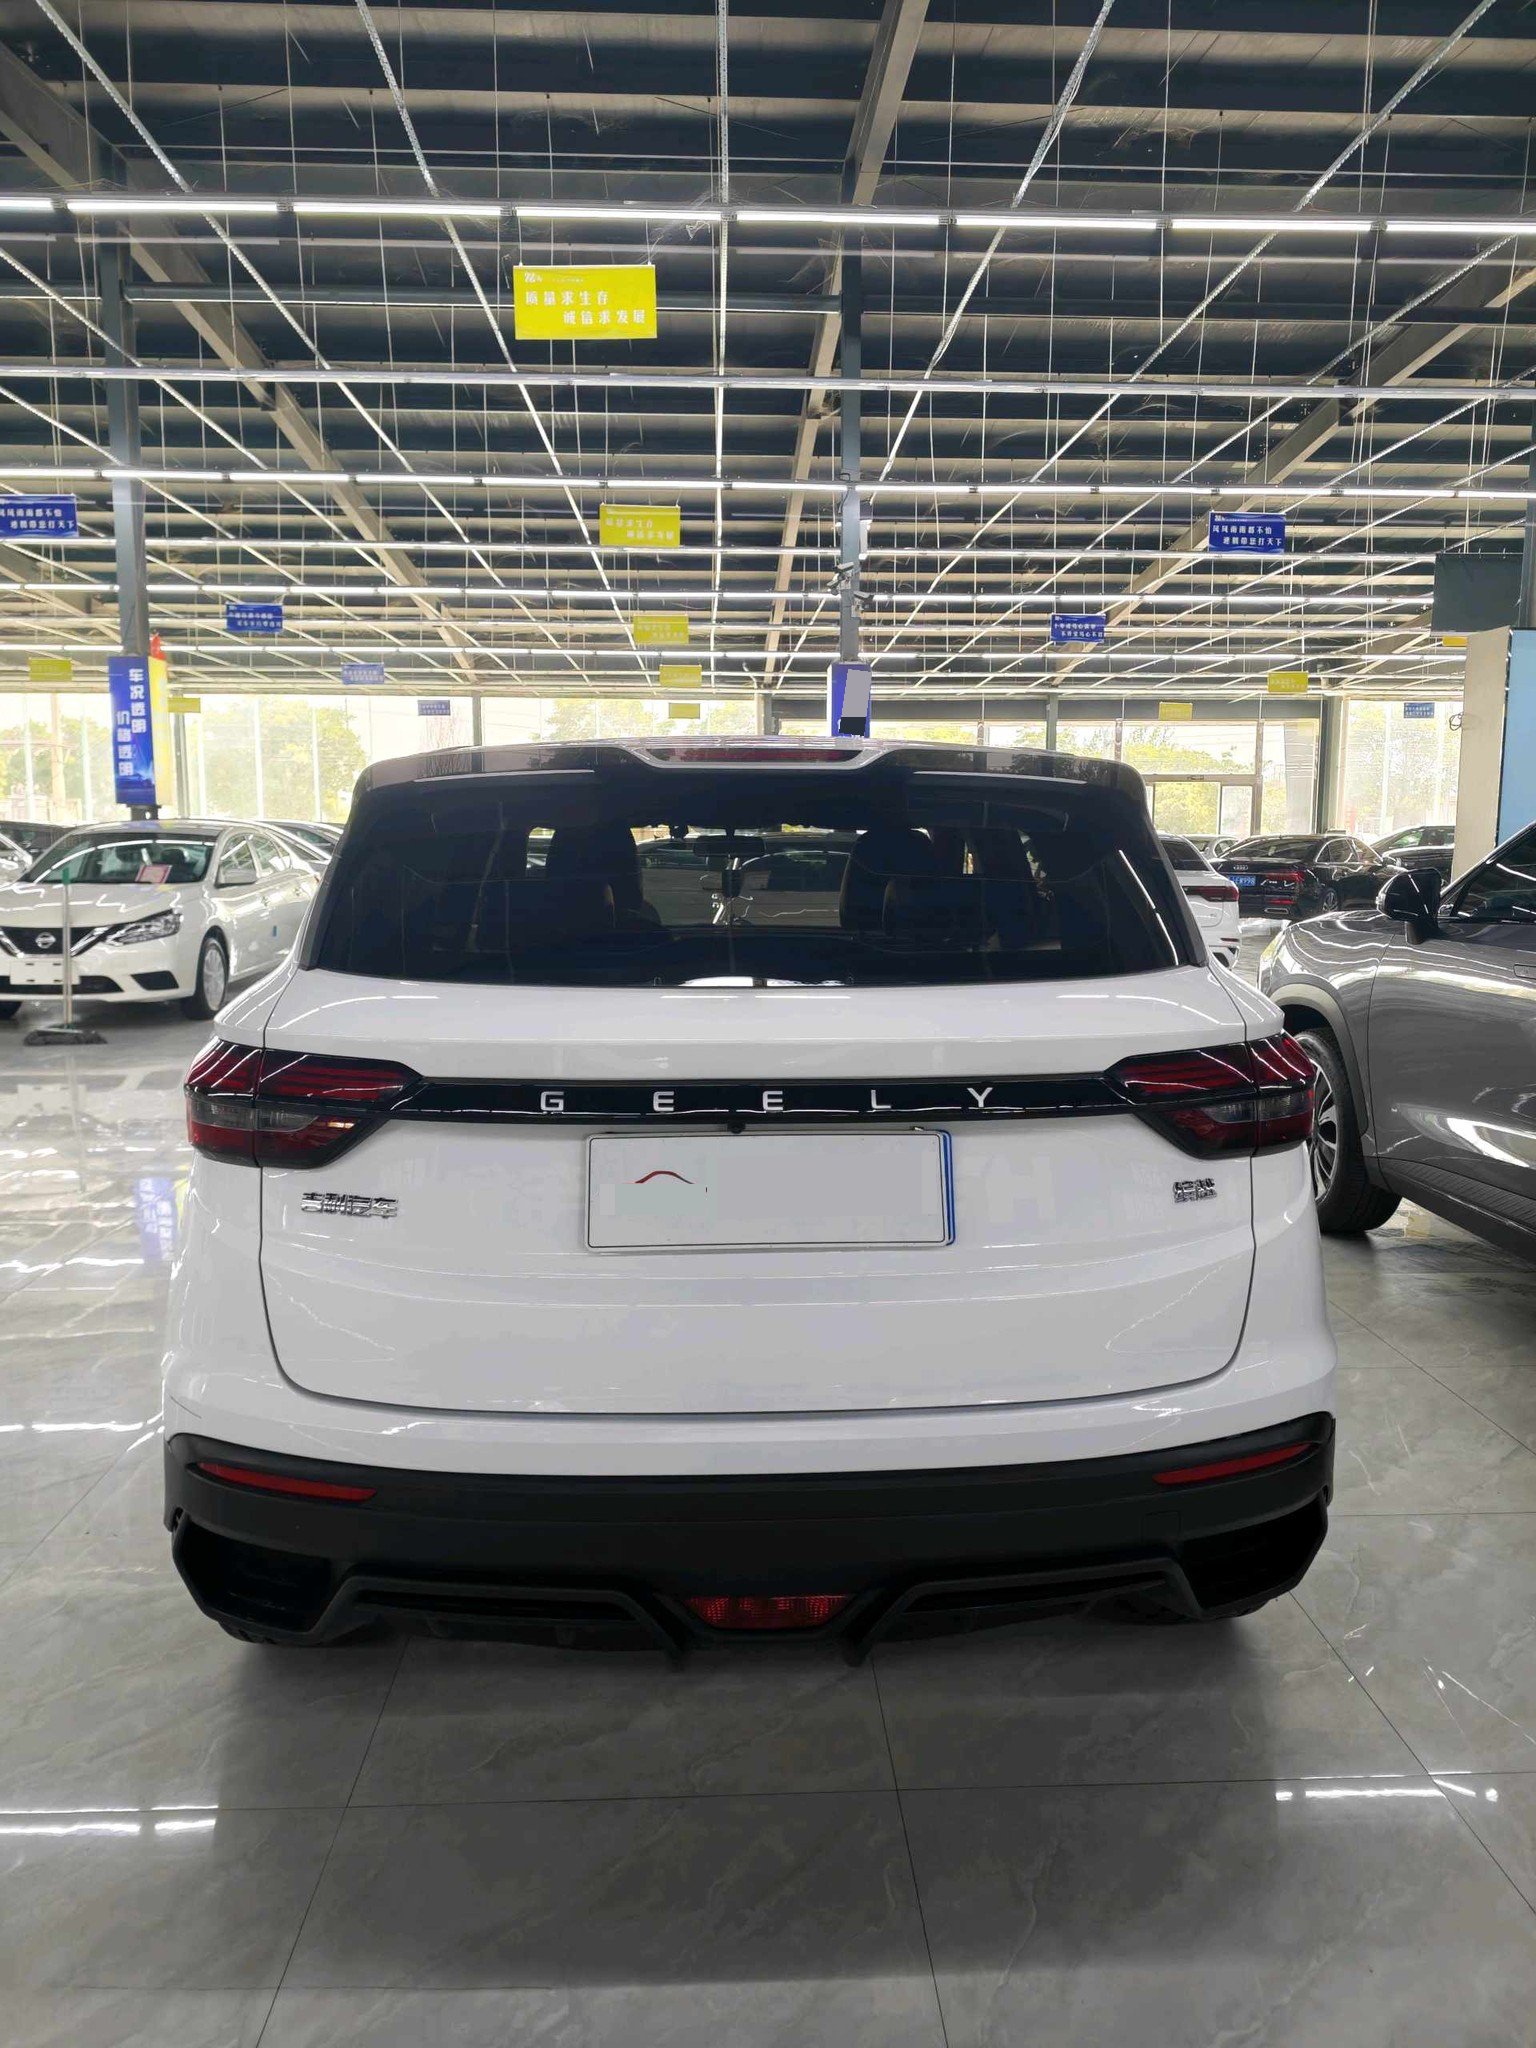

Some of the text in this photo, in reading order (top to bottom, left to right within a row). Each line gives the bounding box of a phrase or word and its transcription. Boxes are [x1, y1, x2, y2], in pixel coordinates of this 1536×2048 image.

[525, 290, 609, 306] 质量求生存
[563, 309, 646, 325] 诚信求发展
[129, 668, 147, 734] 车况透明
[116, 710, 134, 776] 价格透明
[540, 1087, 993, 1113] GEELY
[301, 1192, 398, 1219] 吉利汽车
